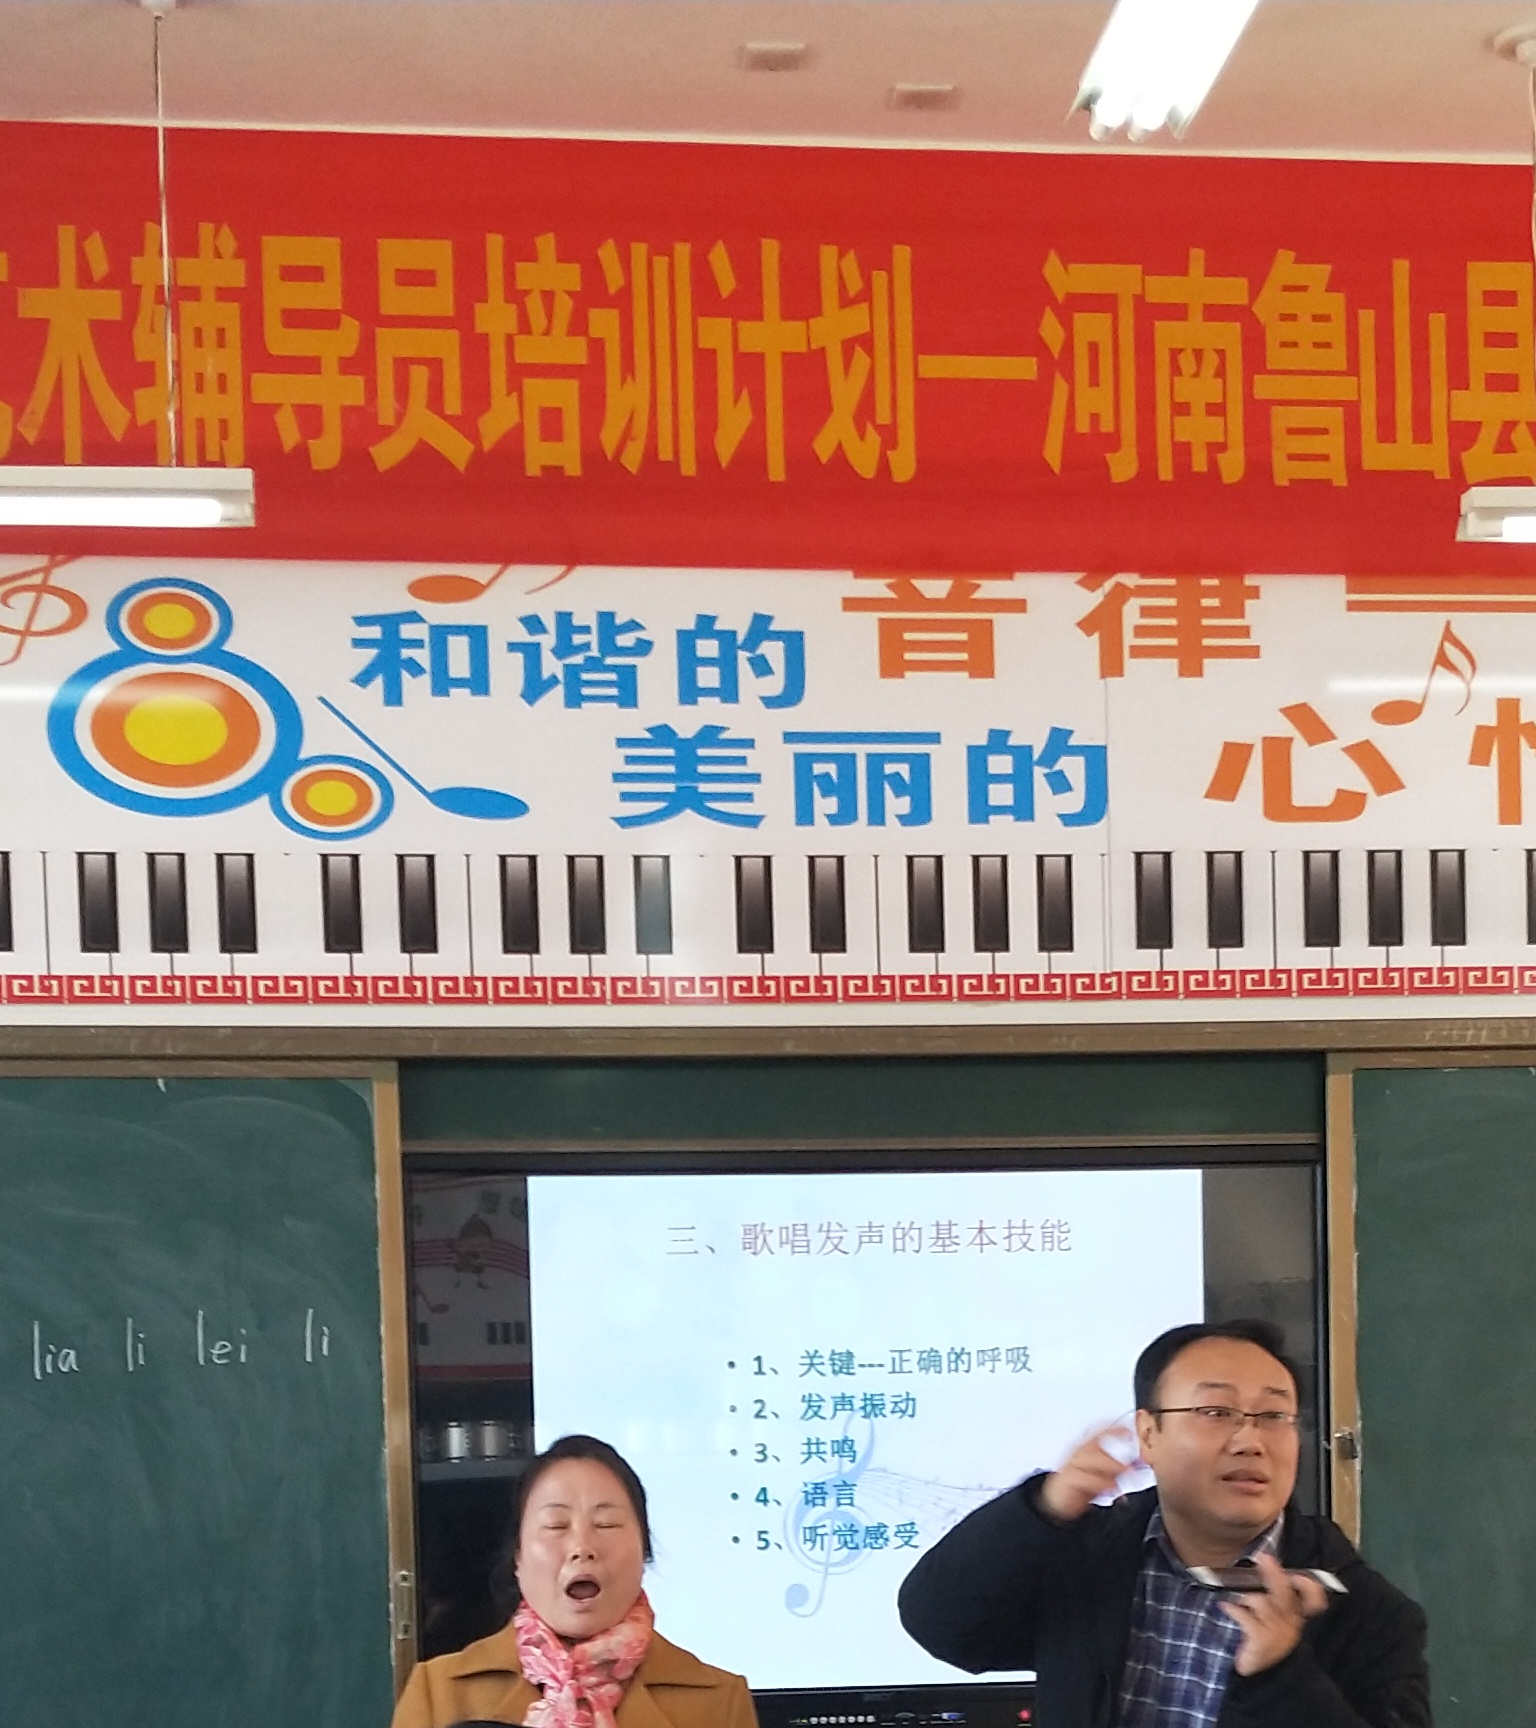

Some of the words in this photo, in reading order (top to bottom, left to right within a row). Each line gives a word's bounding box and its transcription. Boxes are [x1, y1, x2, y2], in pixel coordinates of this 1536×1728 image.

[350, 609, 808, 711] 和谐的
[841, 570, 1261, 680] 音律
[610, 724, 1110, 831] 美丽的
[666, 1218, 1074, 1257] 三、歌唱发声的基本技能
[32, 1320, 80, 1380] lia
[127, 1316, 146, 1372] li
[196, 1309, 249, 1366] lei
[305, 1308, 330, 1363] li
